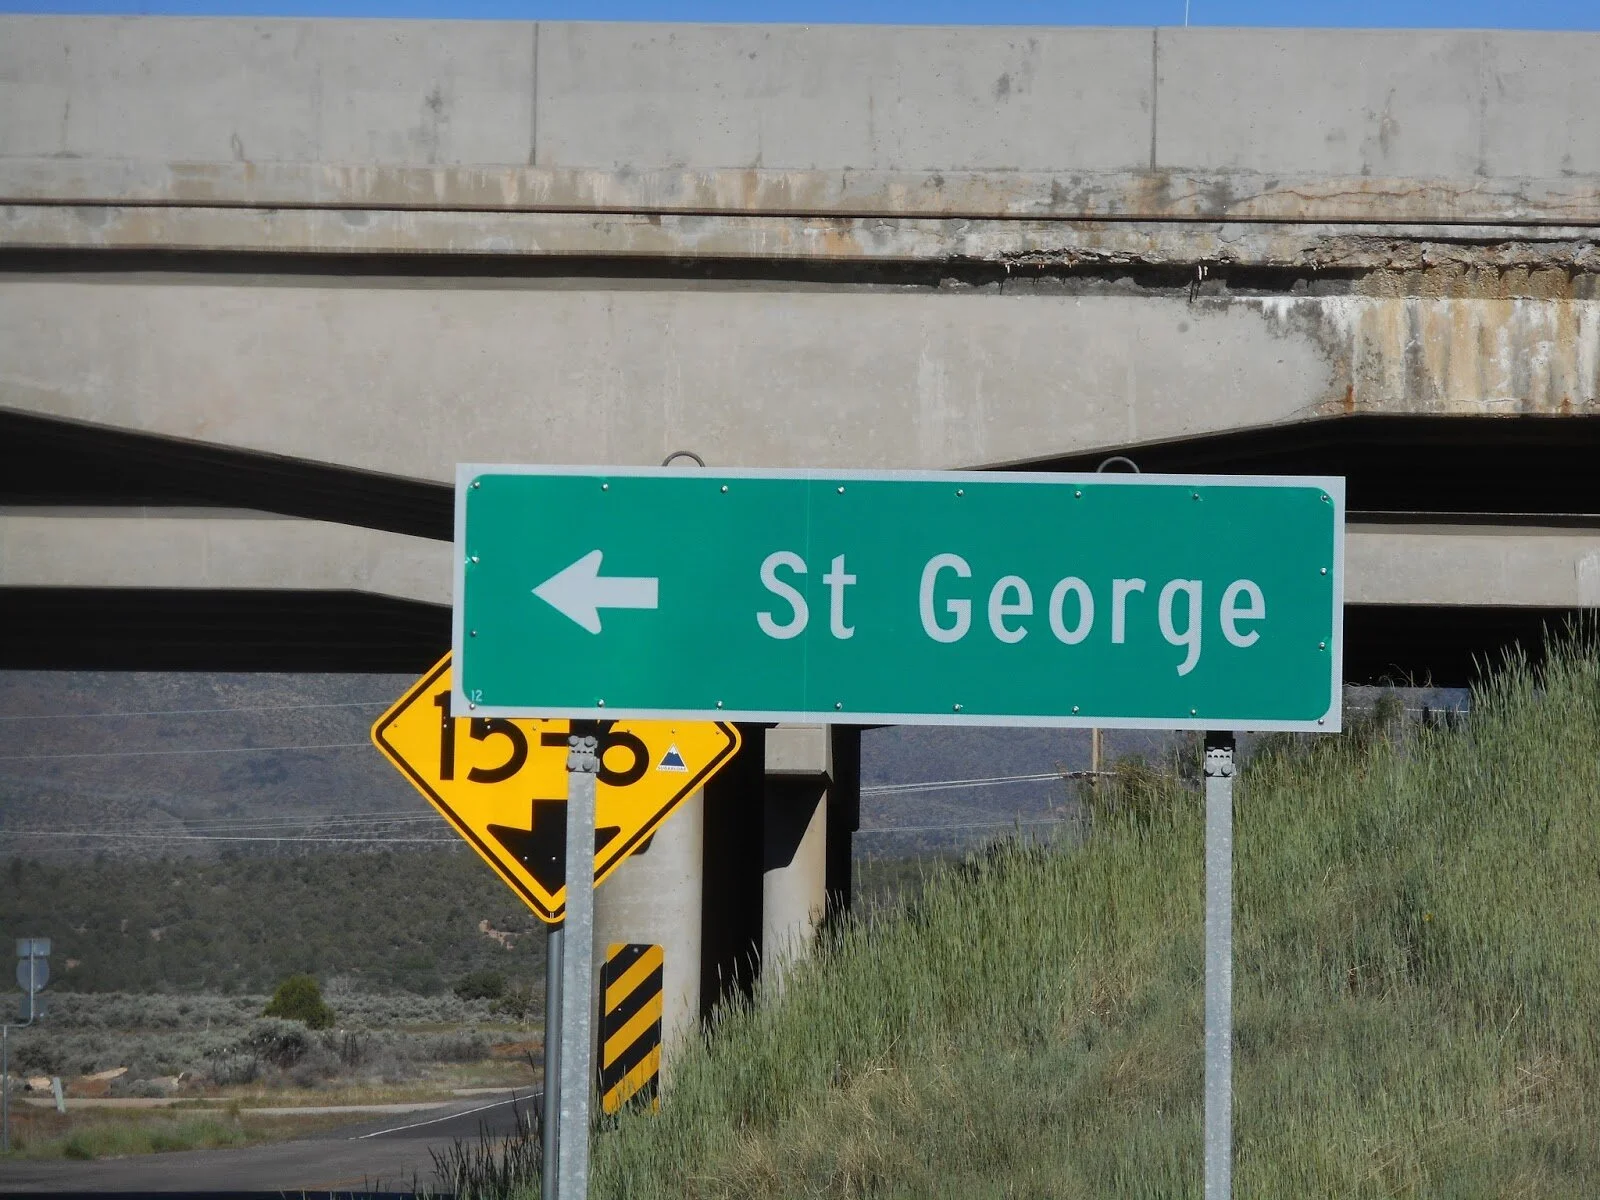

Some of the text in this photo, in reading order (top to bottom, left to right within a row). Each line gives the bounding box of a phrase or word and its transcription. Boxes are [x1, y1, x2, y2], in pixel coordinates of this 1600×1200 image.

[756, 551, 1266, 677] St George
[471, 689, 482, 702] 12
